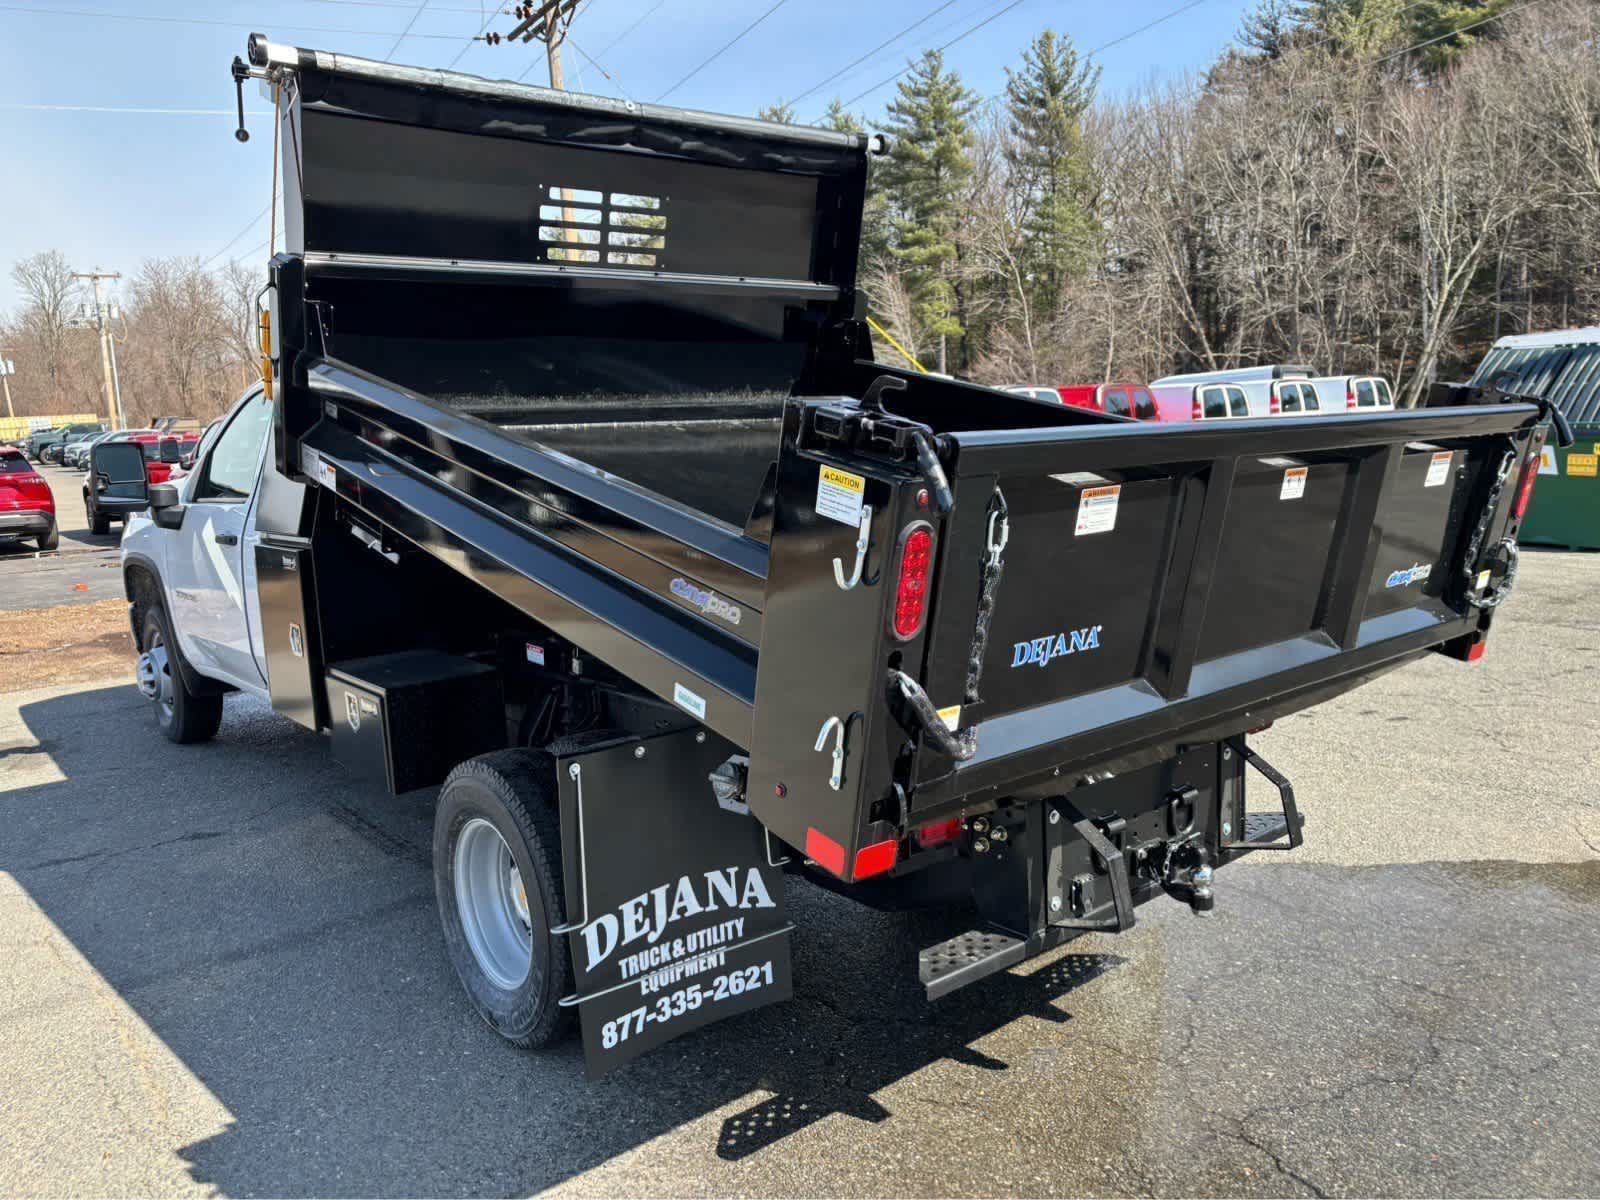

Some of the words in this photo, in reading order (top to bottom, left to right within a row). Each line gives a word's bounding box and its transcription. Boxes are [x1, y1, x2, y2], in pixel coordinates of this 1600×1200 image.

[830, 473, 860, 489] CAUTION
[1010, 625, 1102, 668] DEJANA
[579, 866, 777, 973] DEJANA
[640, 946, 727, 996] EQUIPMENT
[601, 961, 774, 1050] 877-335-2621
